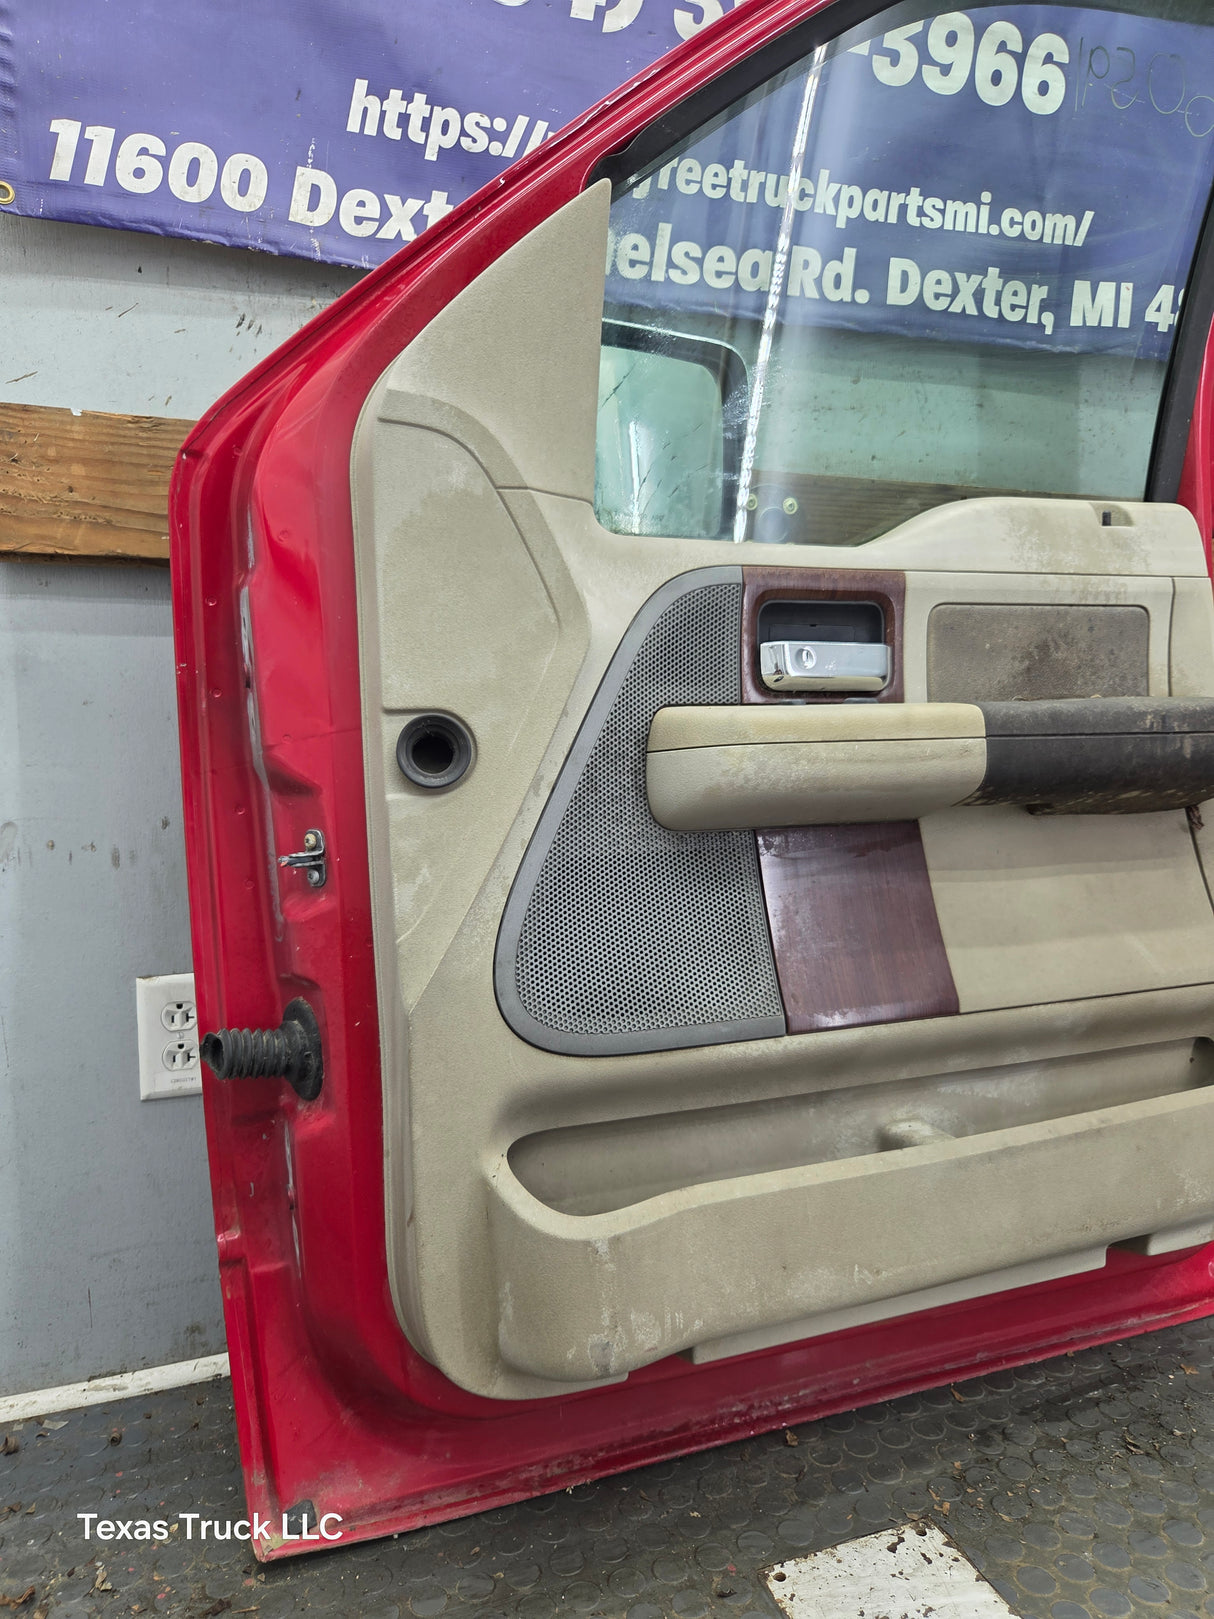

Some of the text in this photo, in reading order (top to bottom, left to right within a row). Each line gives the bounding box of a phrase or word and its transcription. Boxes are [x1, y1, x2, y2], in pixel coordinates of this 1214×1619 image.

[346, 78, 555, 161] https://
[48, 118, 268, 212] 11600
[786, 245, 870, 305] Rd.
[886, 257, 1055, 335] Dexter,
[1070, 280, 1134, 328] MI
[1144, 284, 1185, 333] 4
